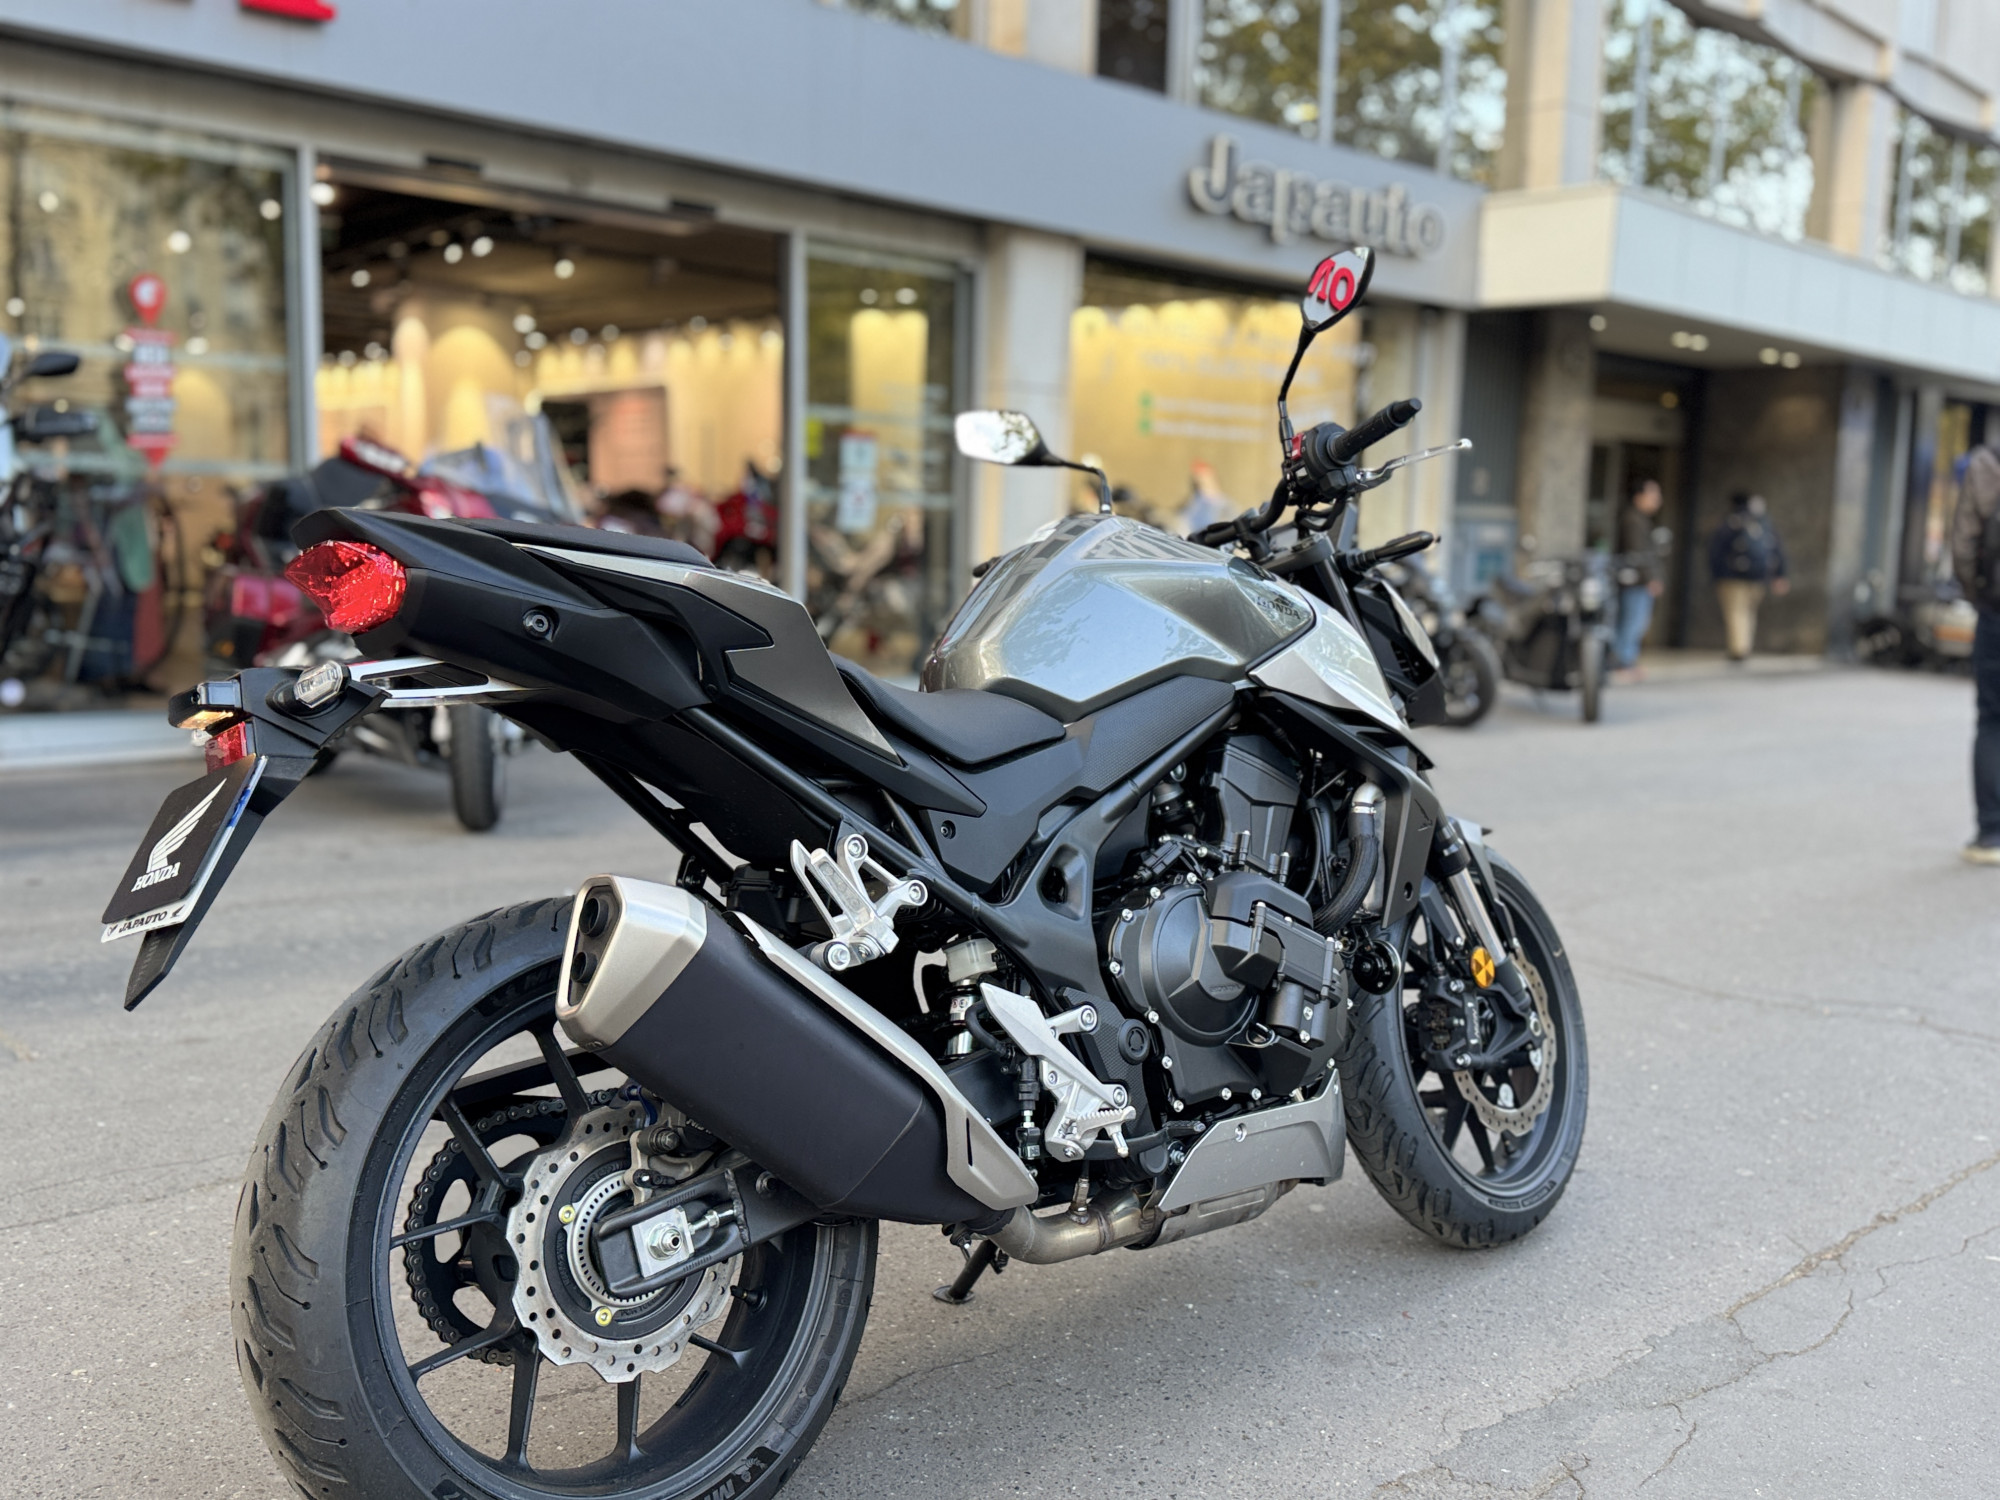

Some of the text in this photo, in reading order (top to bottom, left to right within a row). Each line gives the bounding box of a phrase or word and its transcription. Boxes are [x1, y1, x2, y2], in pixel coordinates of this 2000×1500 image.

[1188, 133, 1444, 258] Japauto
[131, 862, 181, 893] HONDA
[118, 911, 168, 933] JAPAUTO
